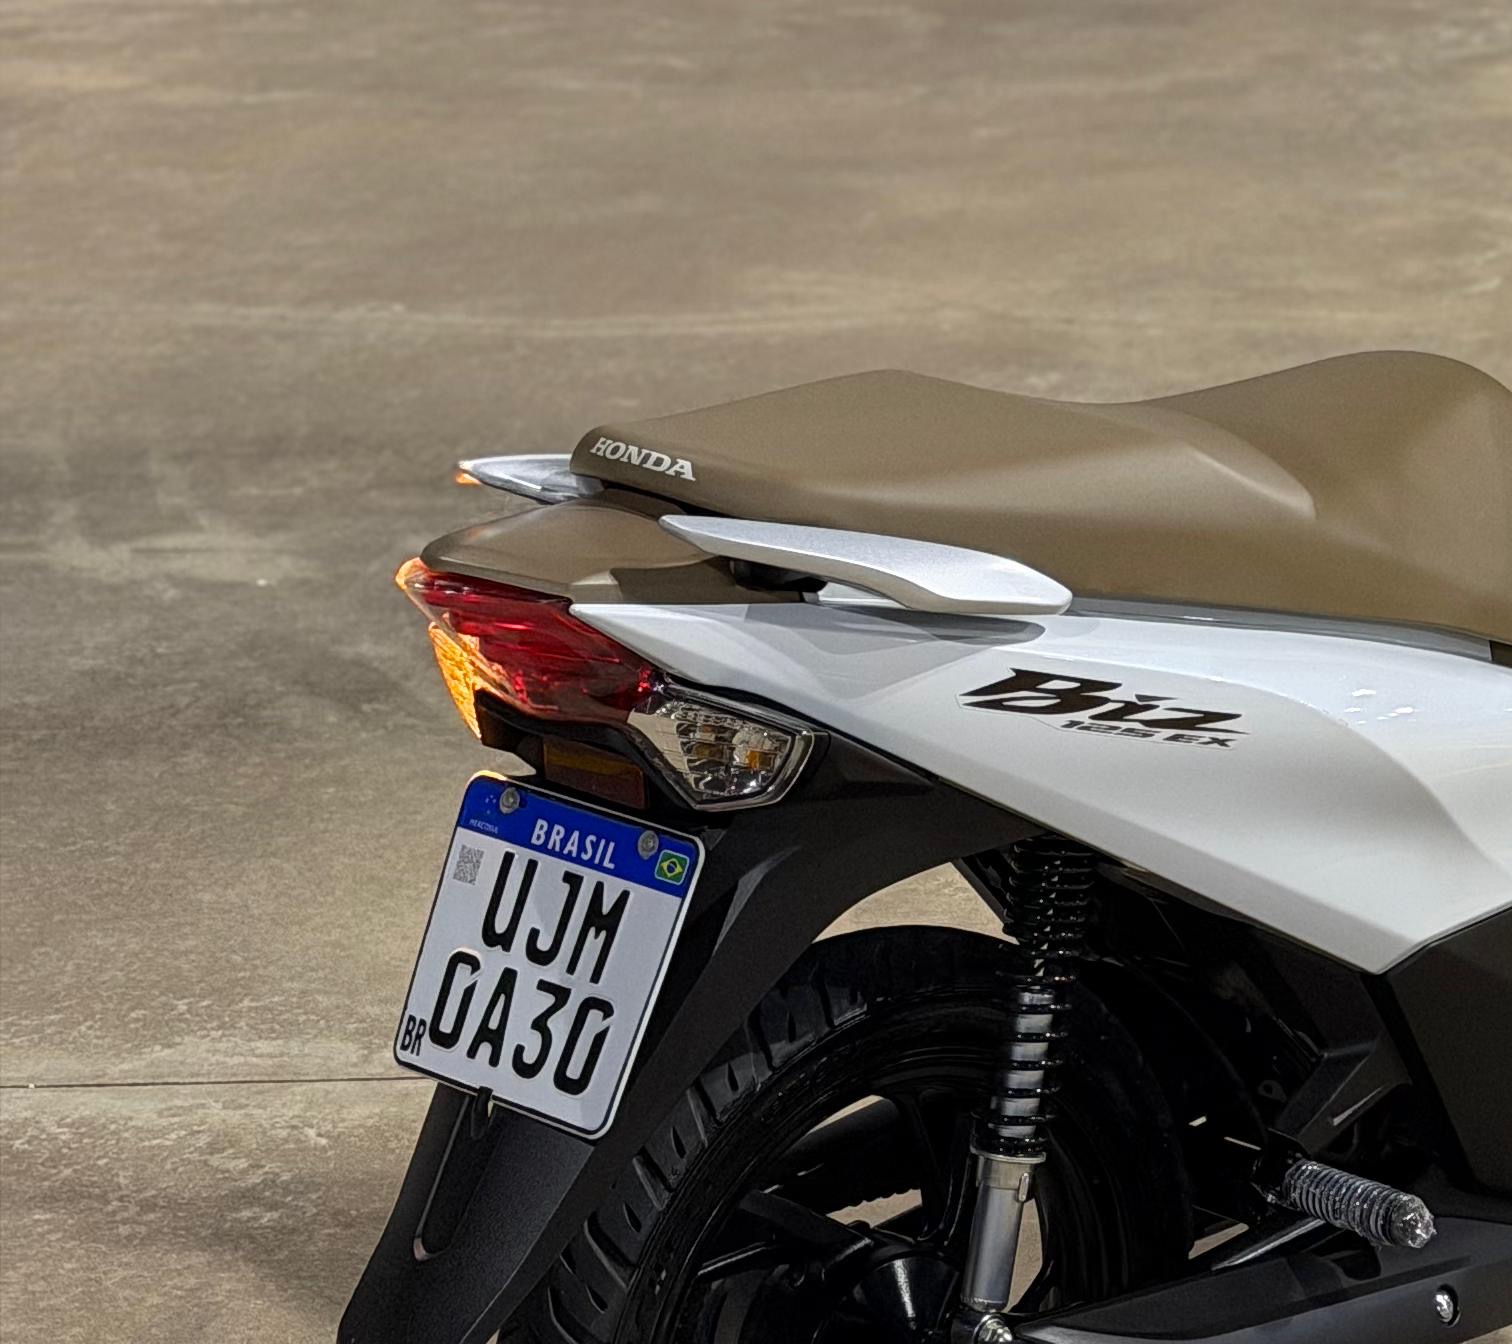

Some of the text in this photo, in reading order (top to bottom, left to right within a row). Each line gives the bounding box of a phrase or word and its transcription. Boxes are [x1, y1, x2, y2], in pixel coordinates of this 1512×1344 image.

[590, 437, 696, 482] HONDA
[959, 667, 1250, 735] Biz
[1060, 719, 1238, 748] 125 EX
[531, 818, 616, 870] BRASIL
[481, 850, 631, 985] UJM
[400, 1014, 427, 1056] BR
[428, 950, 615, 1096] 0A30
